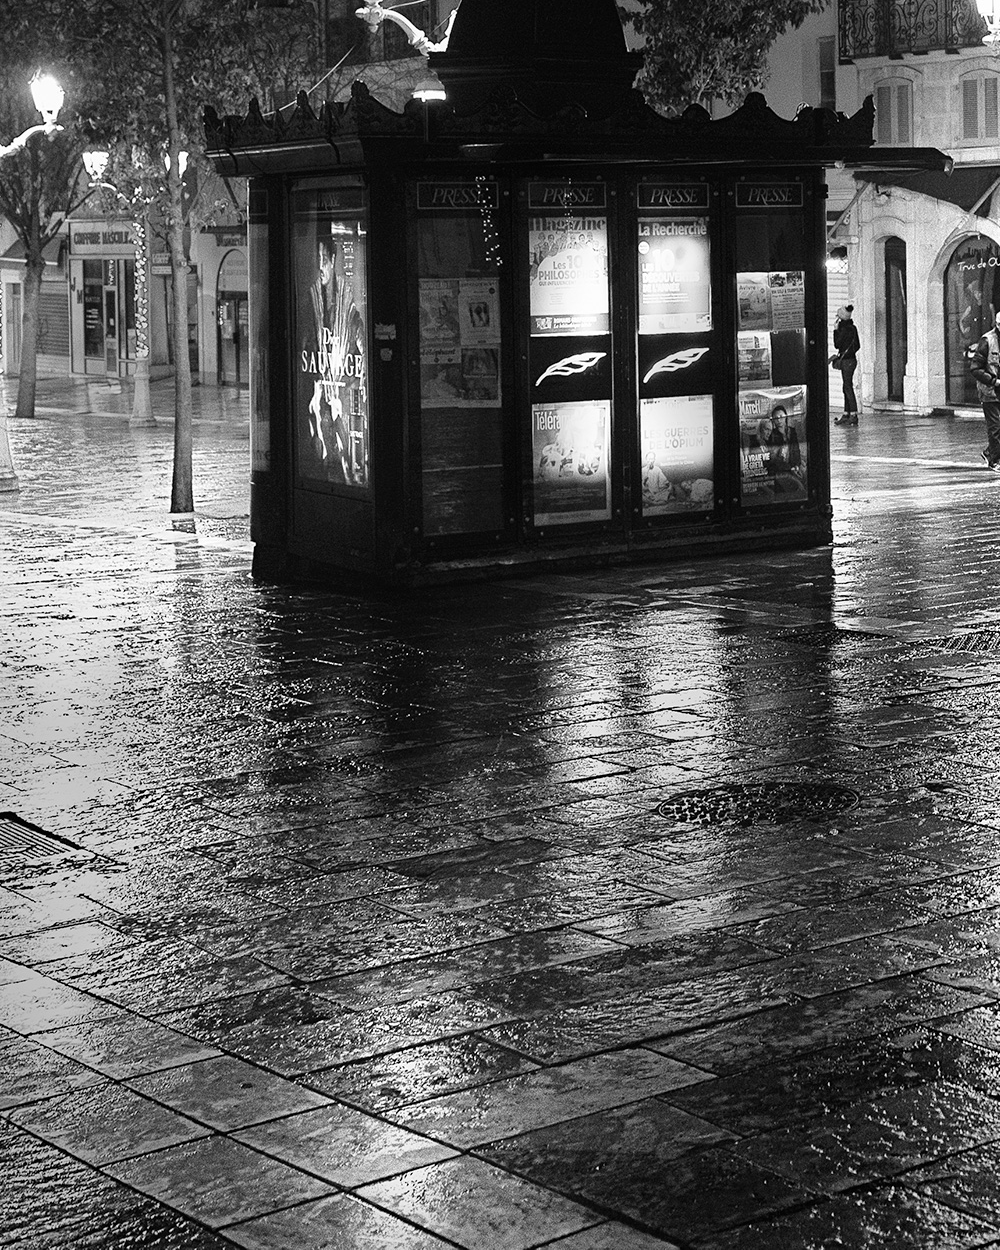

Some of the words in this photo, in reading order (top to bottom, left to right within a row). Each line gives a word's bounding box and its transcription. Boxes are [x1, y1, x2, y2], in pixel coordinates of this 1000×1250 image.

[432, 187, 484, 206] PRESSE
[543, 187, 595, 207] PRESSE
[650, 188, 698, 207] PRESSE
[748, 187, 793, 206] PRESSE
[639, 223, 651, 236] La
[653, 222, 707, 236] Recherche
[553, 260, 567, 270] Les
[566, 254, 583, 269] 10
[652, 248, 675, 272] 10
[957, 261, 976, 272] Truc
[976, 257, 987, 269] de
[301, 350, 363, 378] SAUVAGE
[664, 425, 709, 439] GUERRES
[664, 437, 704, 449] L'OPIUM
